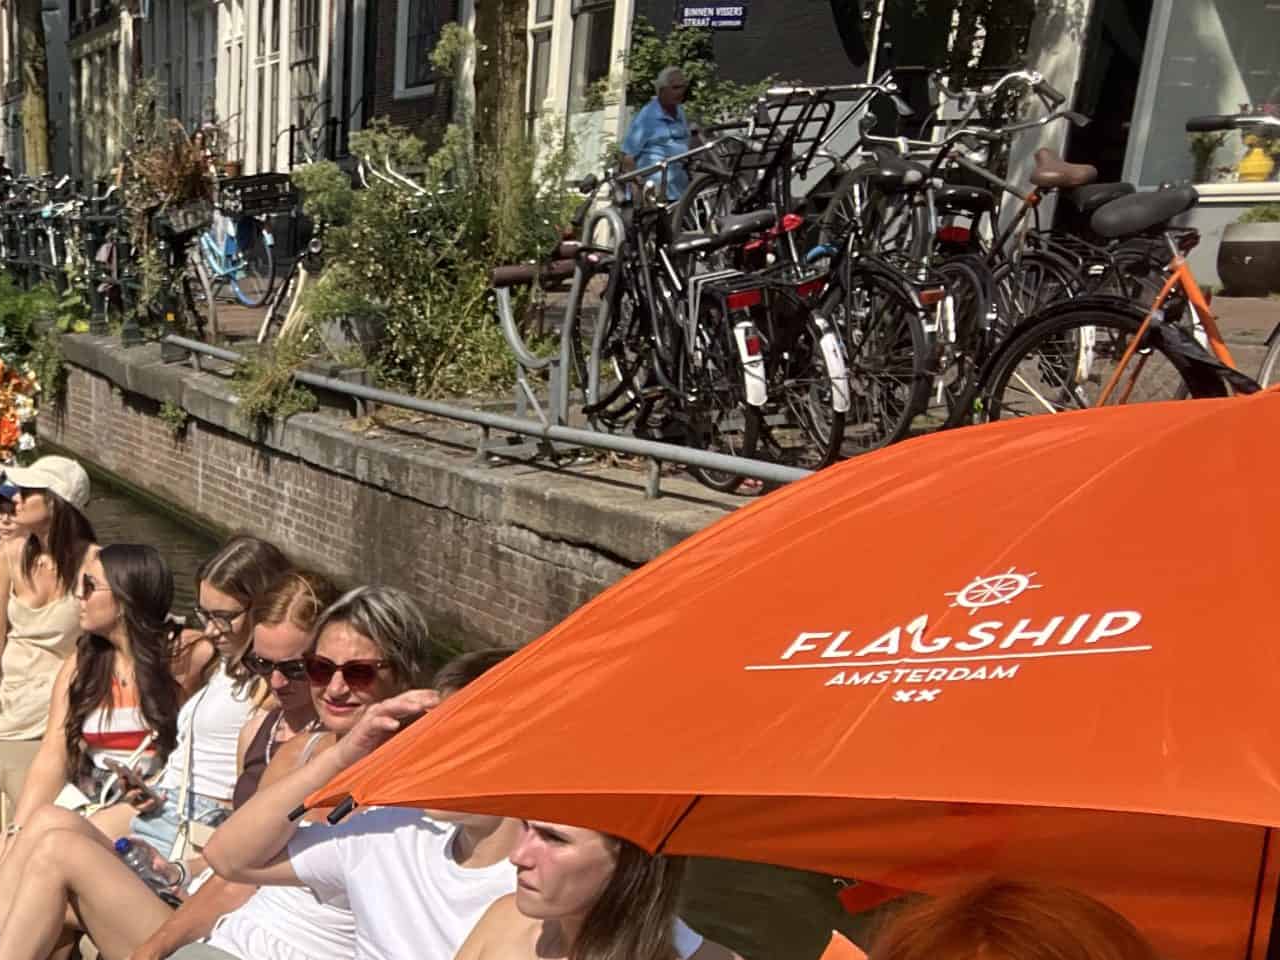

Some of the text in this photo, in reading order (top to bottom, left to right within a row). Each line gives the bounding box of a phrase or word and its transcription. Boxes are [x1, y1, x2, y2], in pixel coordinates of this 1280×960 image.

[684, 6, 744, 17] BINNEN VISSERS
[683, 17, 711, 26] STRAAT
[780, 609, 1143, 660] FLAGSHIP
[824, 663, 1021, 687] AMSTERDAM
